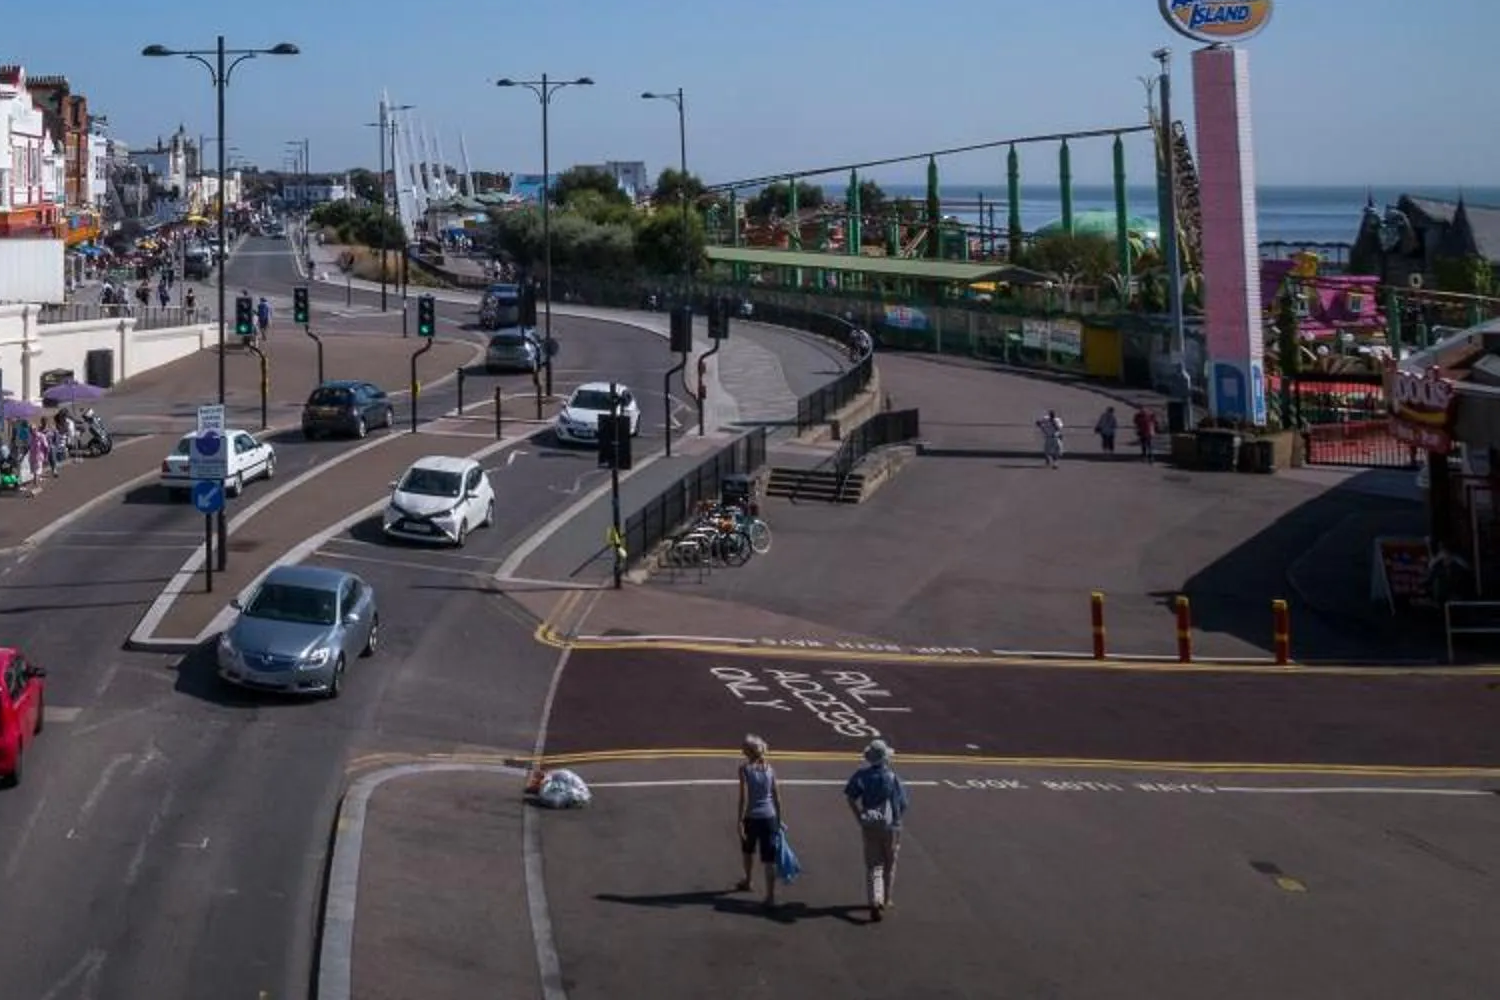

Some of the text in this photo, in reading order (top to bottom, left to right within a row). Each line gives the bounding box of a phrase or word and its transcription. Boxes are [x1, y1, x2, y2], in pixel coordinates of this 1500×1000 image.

[1189, 4, 1249, 28] ISLAND
[710, 667, 793, 711] ONLY
[762, 668, 881, 737] ACCESS
[943, 778, 1217, 793] LOOK BOTH WAYS
